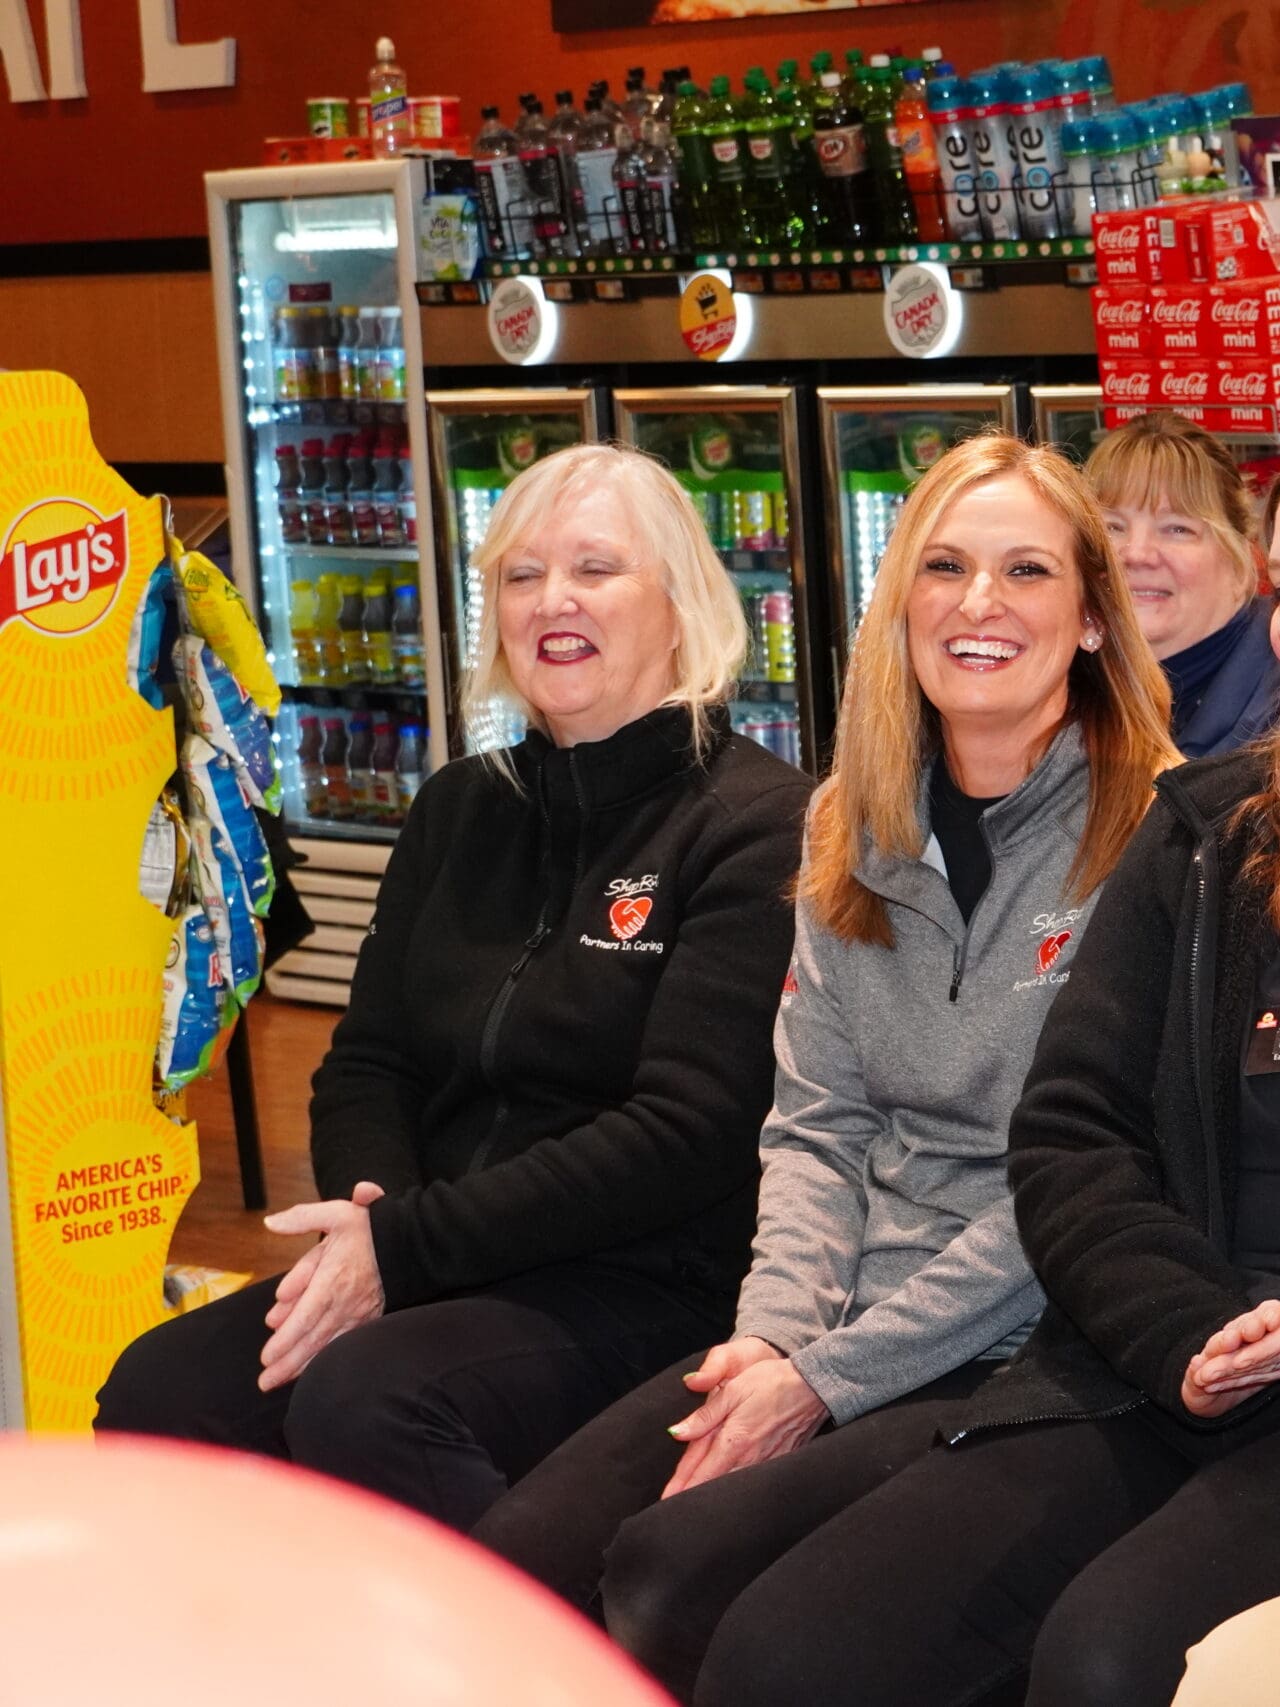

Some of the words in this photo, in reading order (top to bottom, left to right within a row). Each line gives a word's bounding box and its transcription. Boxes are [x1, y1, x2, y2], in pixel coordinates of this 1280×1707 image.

[1107, 256, 1137, 275] mini
[496, 305, 535, 337] CANADA
[895, 292, 940, 330] CANADA
[911, 311, 933, 335] DRY
[1108, 331, 1139, 348] mini
[1164, 330, 1197, 347] mini
[1223, 330, 1256, 347] mini
[13, 522, 116, 612] Lay's
[579, 934, 619, 951] Partners
[622, 940, 632, 951] In
[633, 940, 664, 954] Caring
[56, 1153, 163, 1192] AMERICA'S
[35, 1187, 132, 1223] FAVORITE
[61, 1222, 114, 1245] Since
[120, 1206, 167, 1233] 1938.
